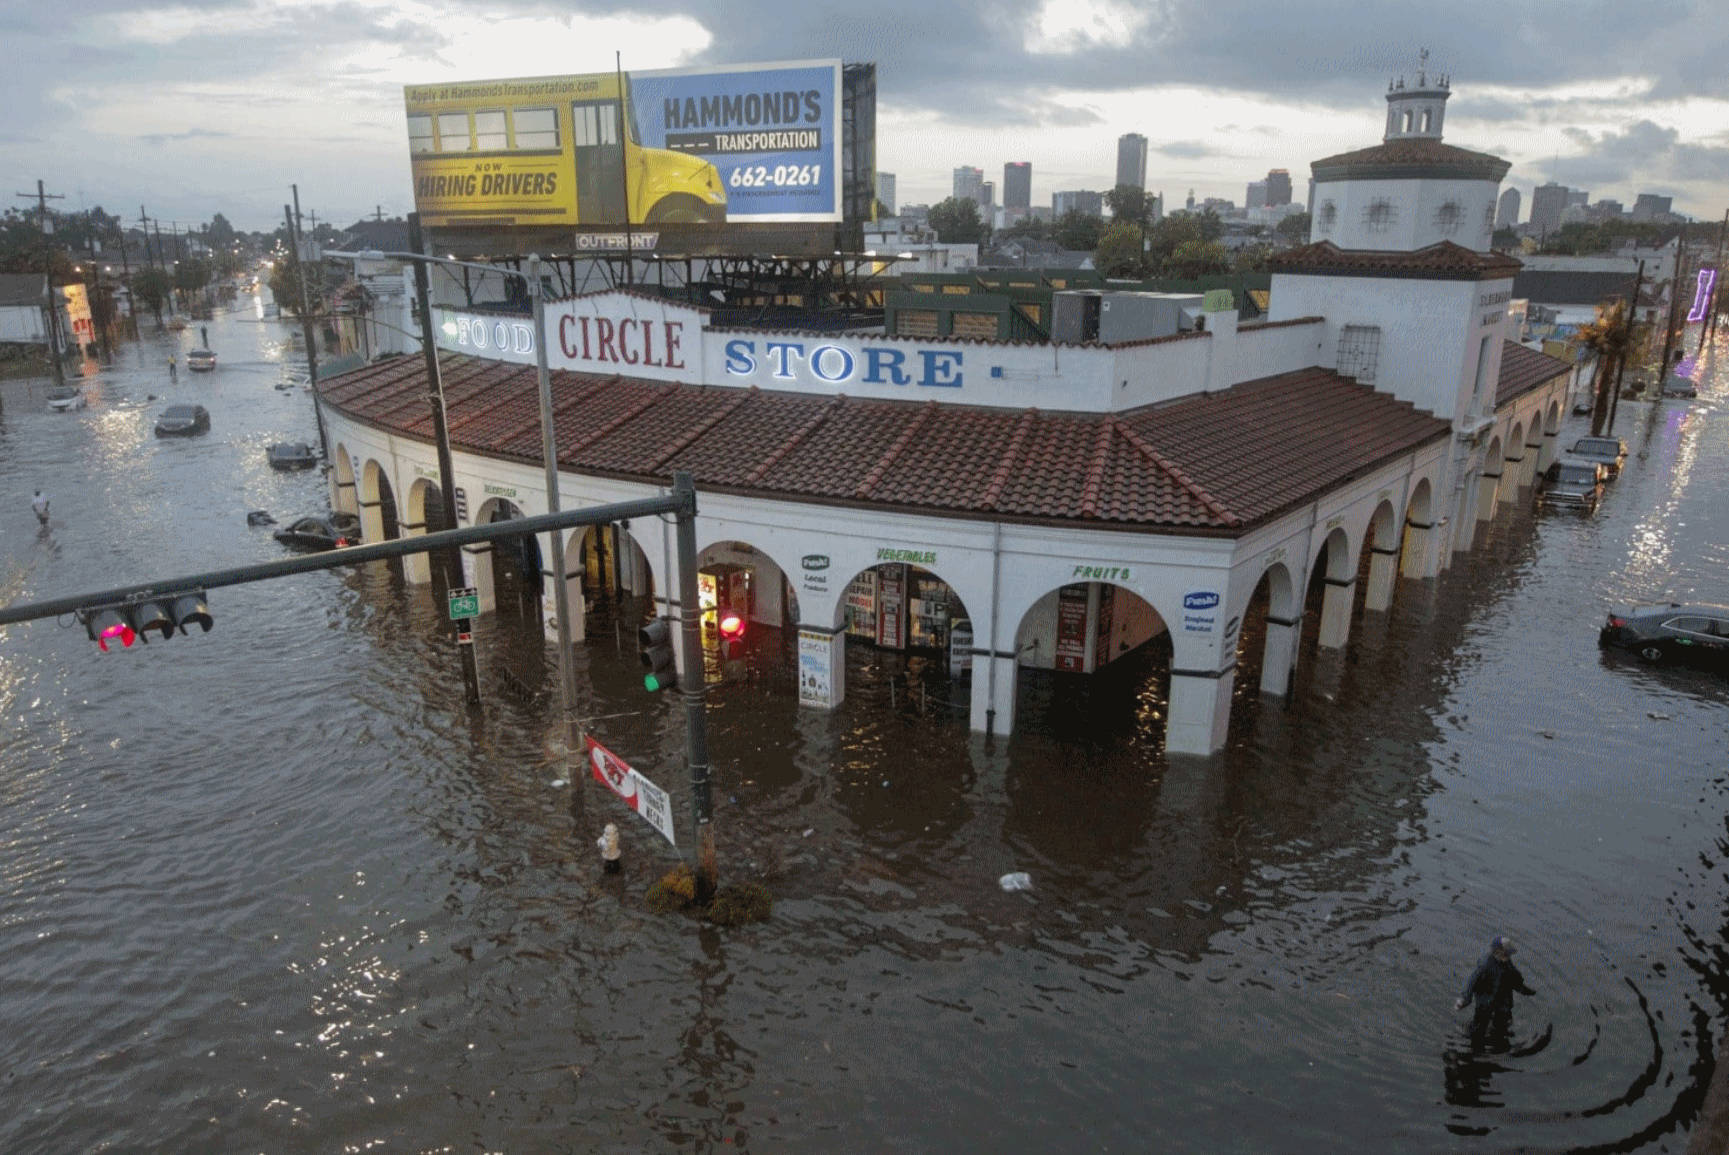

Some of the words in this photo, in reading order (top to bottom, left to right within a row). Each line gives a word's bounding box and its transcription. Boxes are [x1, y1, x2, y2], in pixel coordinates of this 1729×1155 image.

[664, 89, 821, 129] HAMMOND'S
[715, 131, 818, 151] TRANSPORTATION
[475, 163, 502, 172] NOW
[730, 164, 821, 187] 662-0261
[418, 174, 477, 197] HIRING
[481, 172, 557, 196] DRIVERS
[579, 235, 654, 247] OUTFRONT
[457, 317, 534, 354] FOOD
[559, 314, 685, 369] CIRCLE
[725, 339, 963, 388] STORE
[876, 548, 937, 564] VEGETABLES
[804, 573, 827, 584] Local
[1073, 566, 1130, 579] FRUITS
